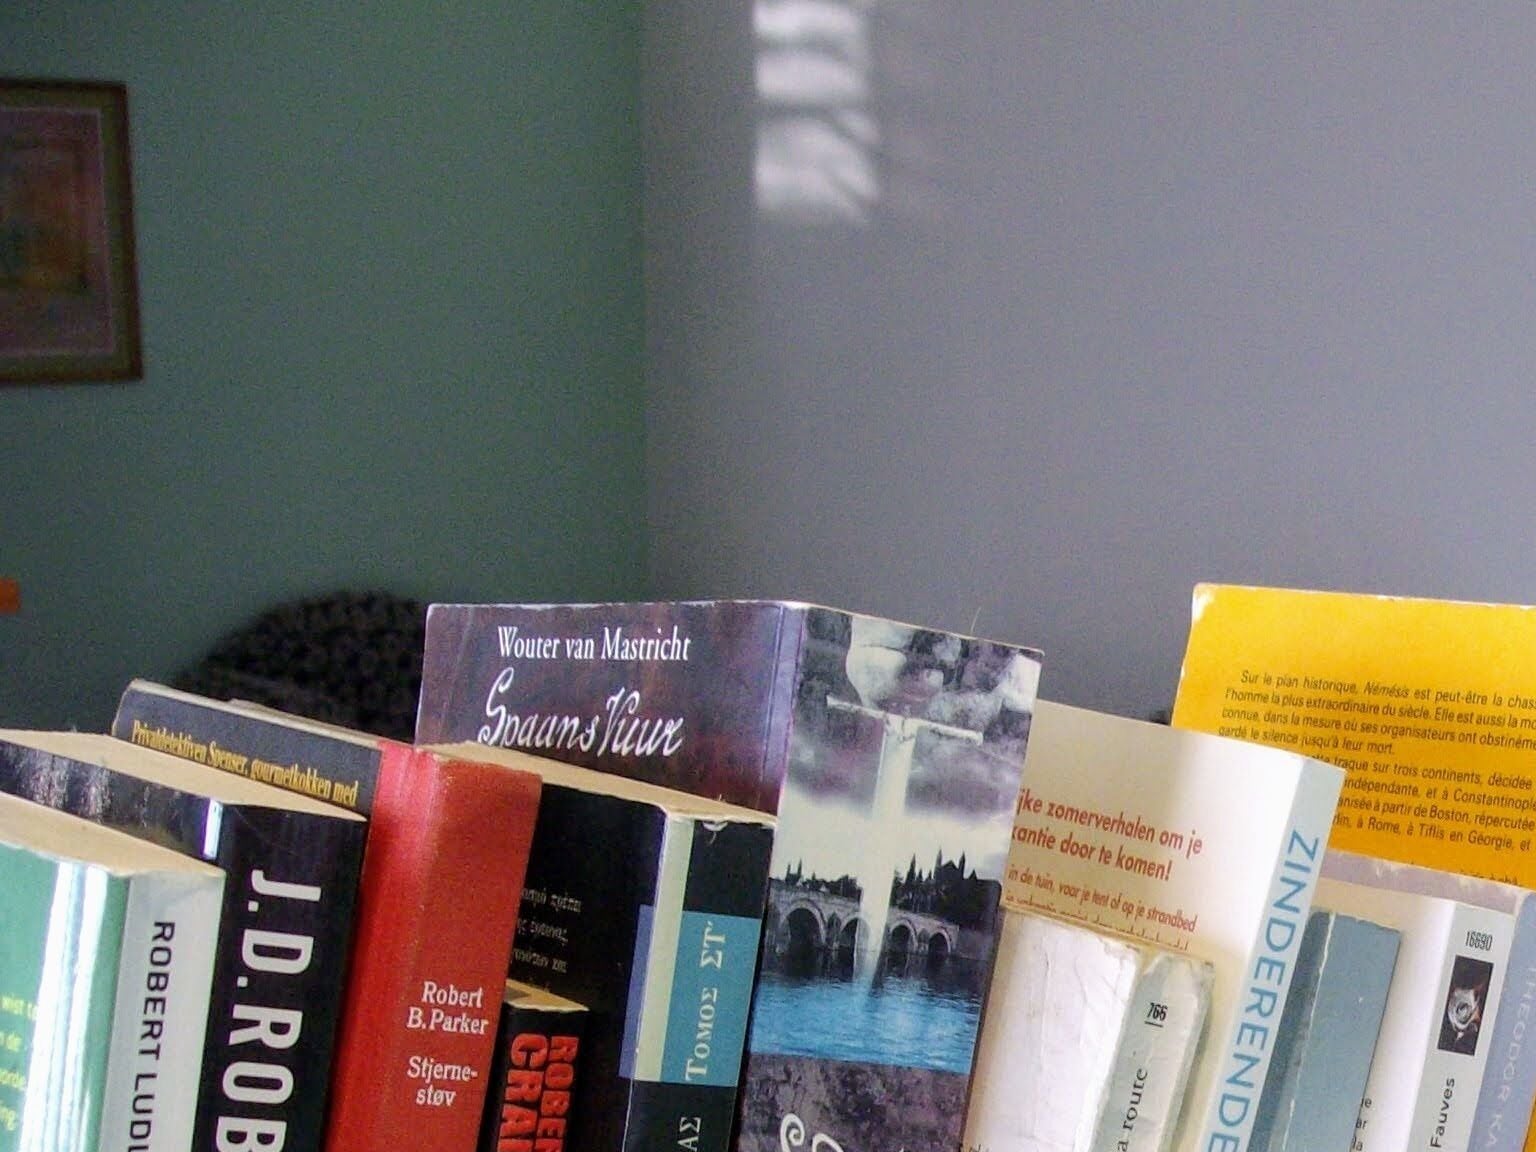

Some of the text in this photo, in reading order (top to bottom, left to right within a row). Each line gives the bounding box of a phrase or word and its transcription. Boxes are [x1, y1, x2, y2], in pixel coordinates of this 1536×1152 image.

[498, 625, 690, 662] Wouter van Mastricht
[1303, 675, 1359, 697] historique,
[1047, 803, 1203, 857] zomerverhalen om je
[1060, 832, 1172, 882] door komen!
[1146, 904, 1197, 933] strandbed
[1465, 930, 1493, 952] 16690
[134, 920, 175, 1061] ROBERT
[421, 981, 482, 1008] Robert
[1145, 1002, 1168, 1021] 766
[407, 1056, 478, 1083] Stjerne-
[416, 1083, 455, 1107] støv
[1124, 1067, 1148, 1136] route
[1431, 1078, 1455, 1149] Fauves
